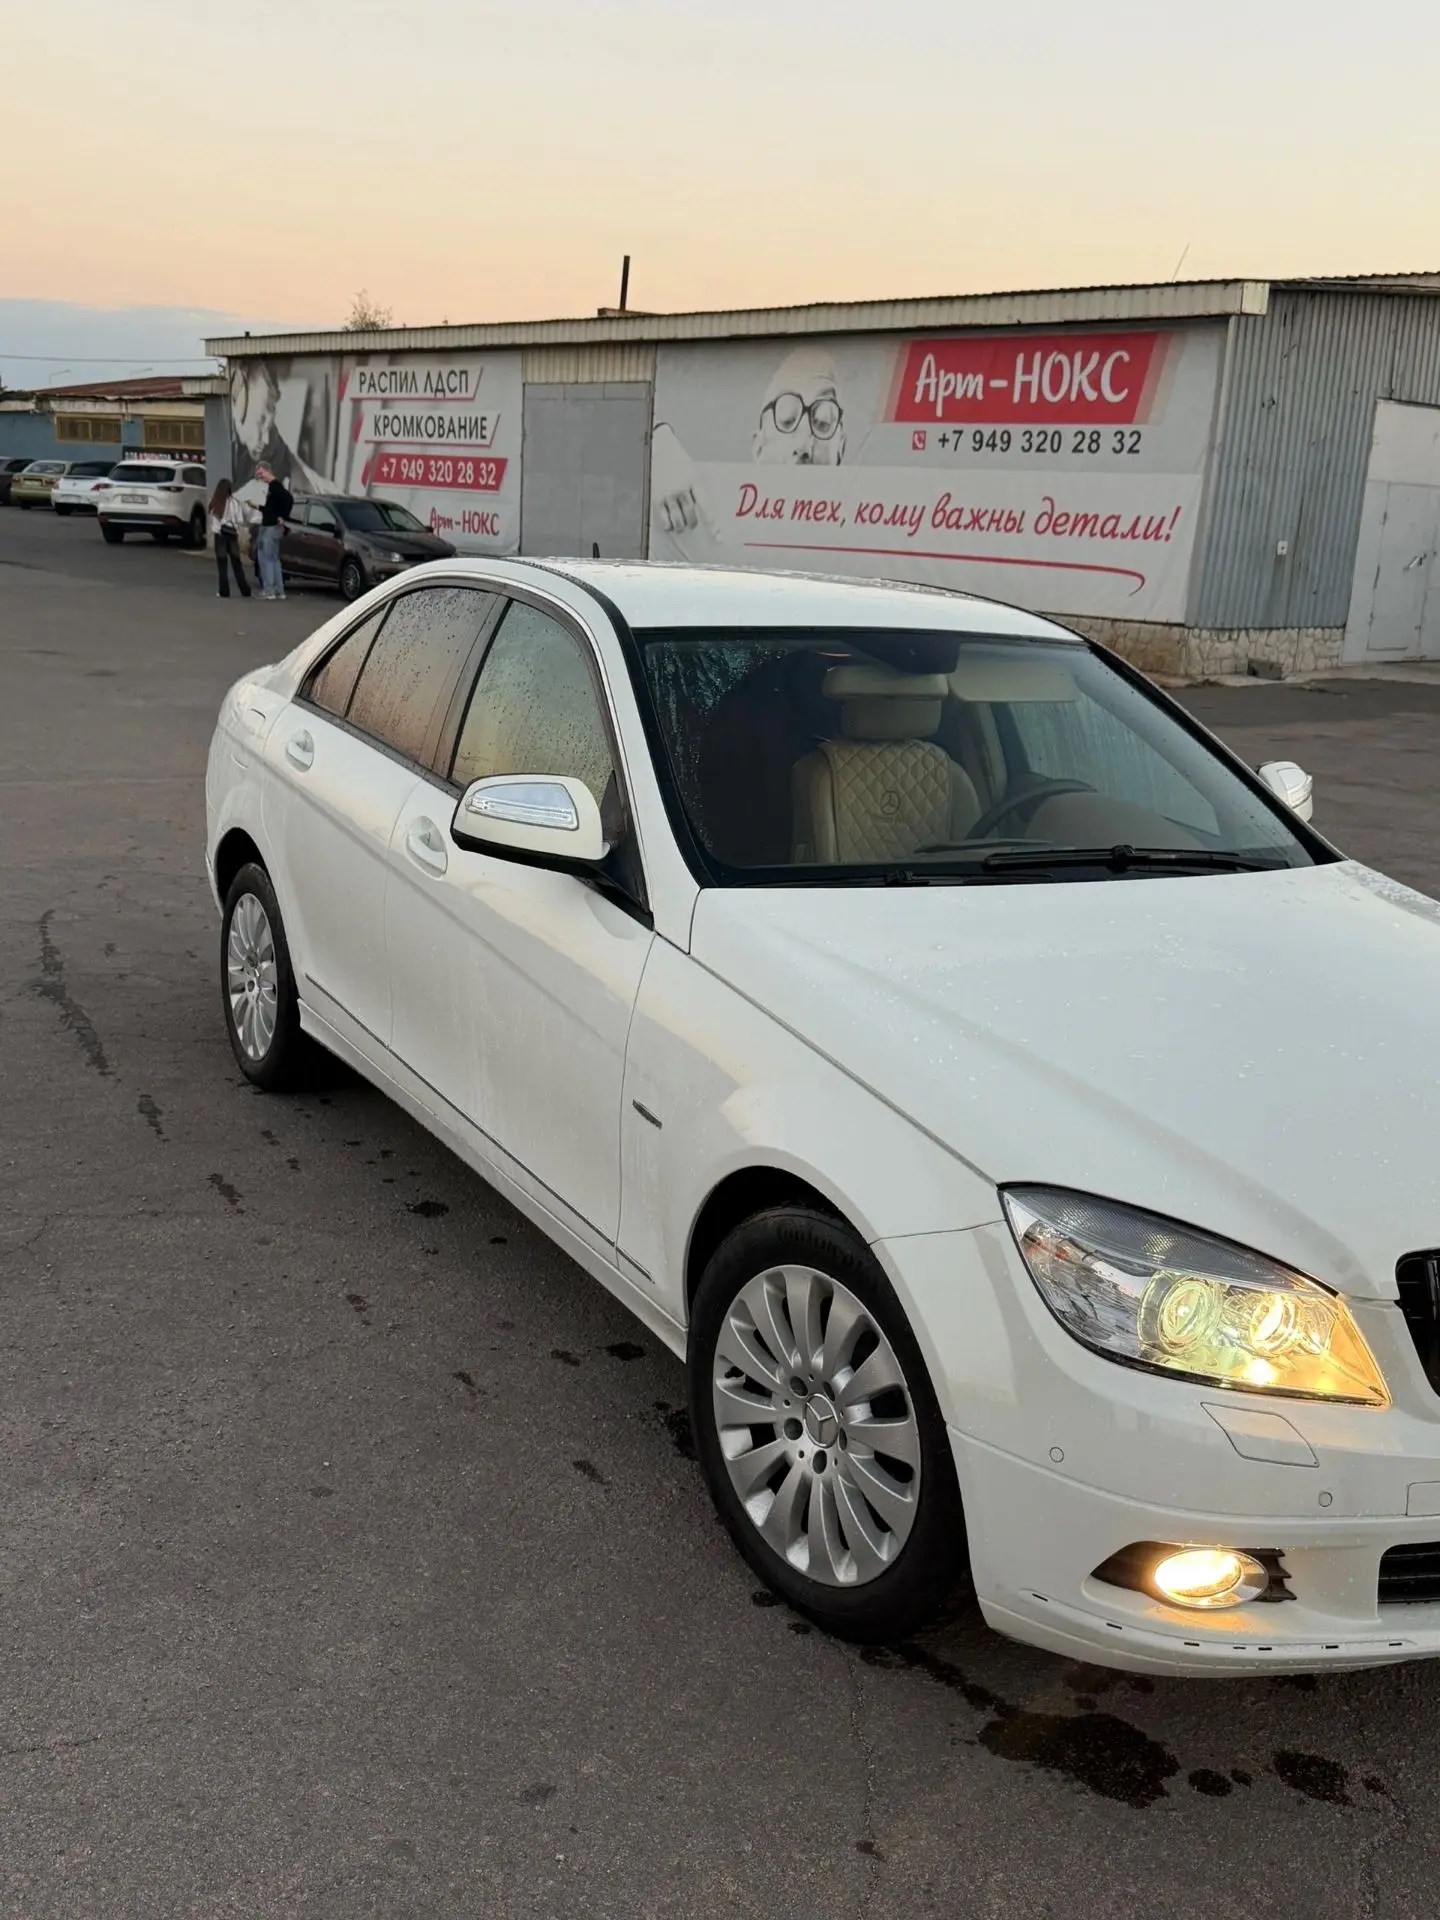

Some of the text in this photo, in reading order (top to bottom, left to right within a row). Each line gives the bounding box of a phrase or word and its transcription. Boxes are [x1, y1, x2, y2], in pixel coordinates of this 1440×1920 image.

[359, 370, 469, 397] РАСПИЛ ЛДСП
[914, 350, 1130, 417] Арт-НОКС
[374, 414, 487, 440] КРОМКОВАНИЕ
[938, 429, 1142, 454] +7 949 320 28 32
[382, 458, 496, 486] +7 949 320 28 32
[736, 483, 1182, 542] Для тех, кому важны детали!
